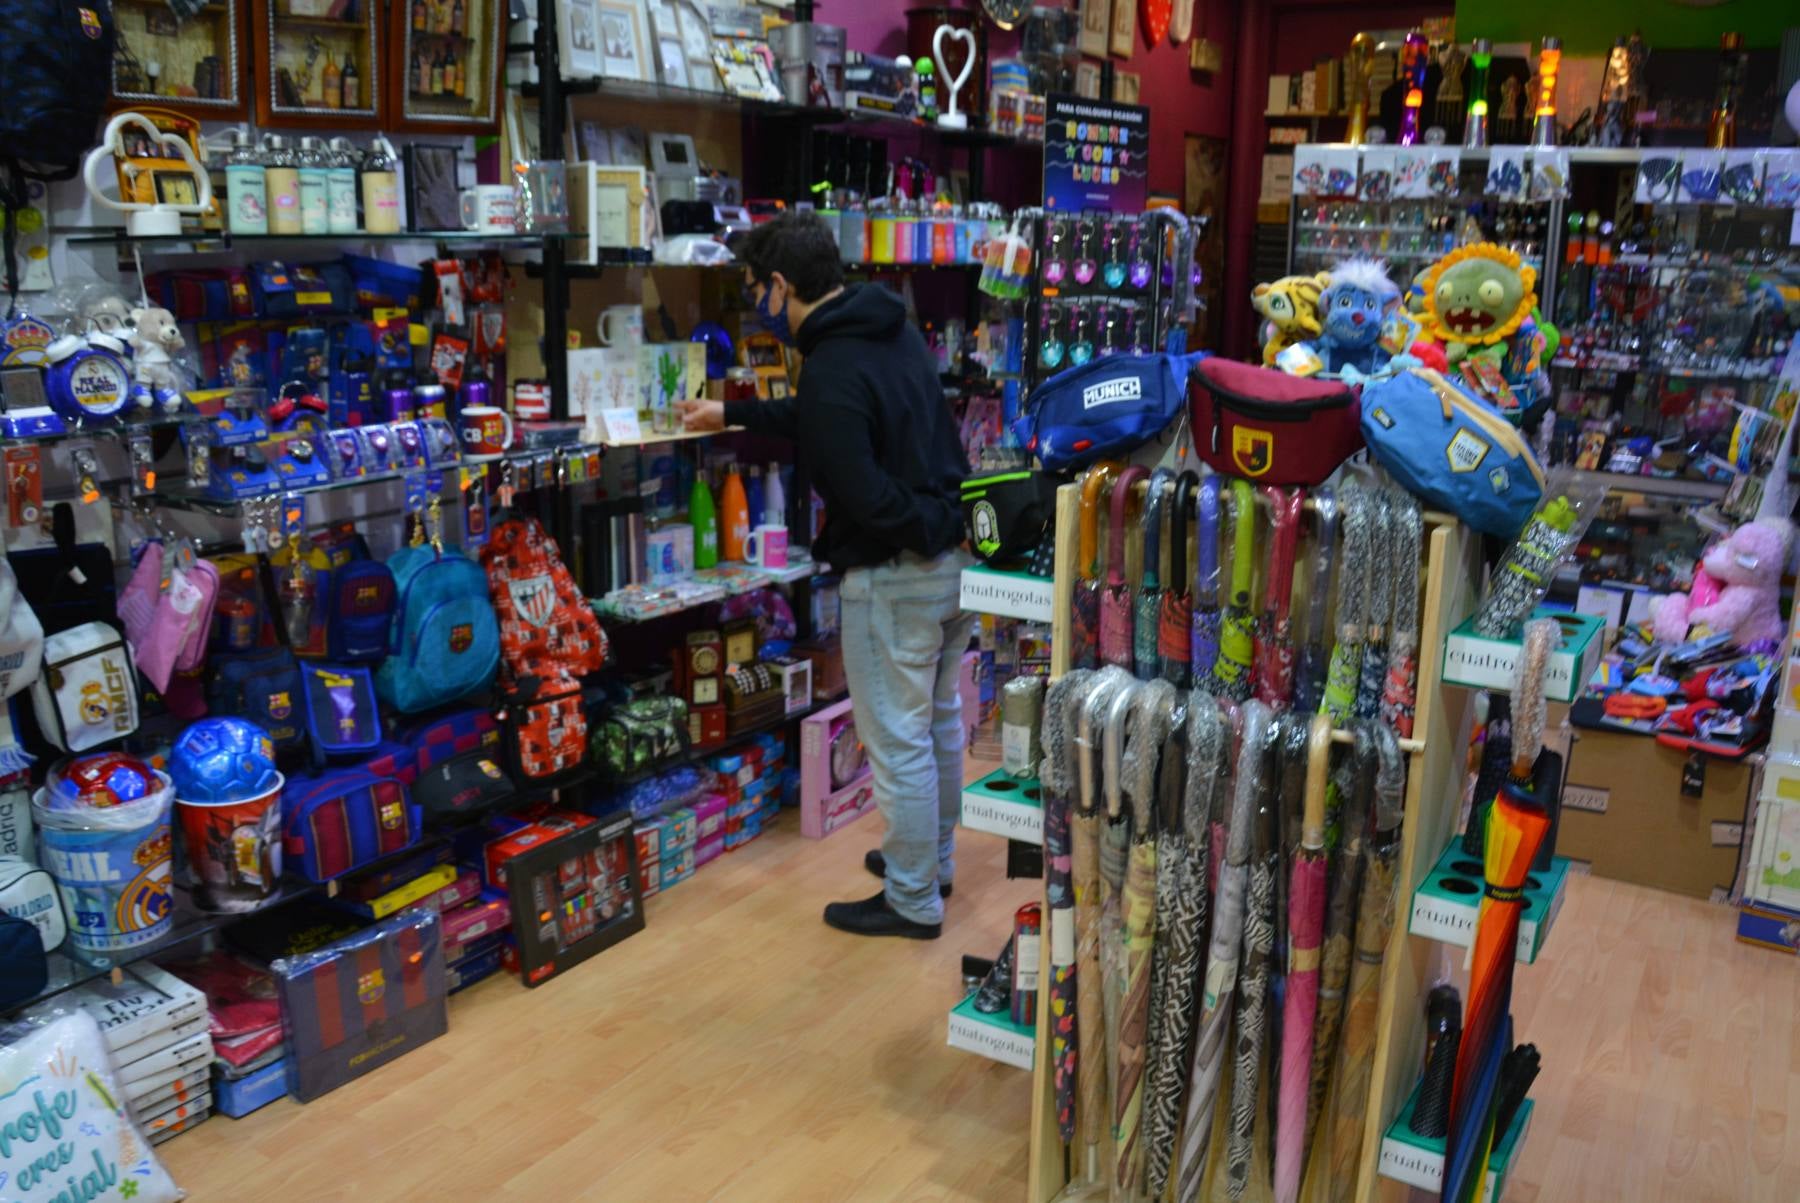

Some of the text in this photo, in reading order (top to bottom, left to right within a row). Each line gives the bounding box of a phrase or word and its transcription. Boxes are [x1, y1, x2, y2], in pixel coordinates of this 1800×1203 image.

[1065, 120, 1129, 145] NOMBRE
[1082, 143, 1113, 164] CON
[1073, 162, 1119, 186] LUCES
[1083, 376, 1141, 410] MUNICH
[963, 583, 1051, 607] cuatrogotas
[1450, 649, 1568, 682] cuatroas
[0, 803, 19, 854] adrid
[964, 802, 1041, 830] cuatrogota
[950, 1023, 1031, 1057] cuatrogotas
[17, 1141, 74, 1191] eres
